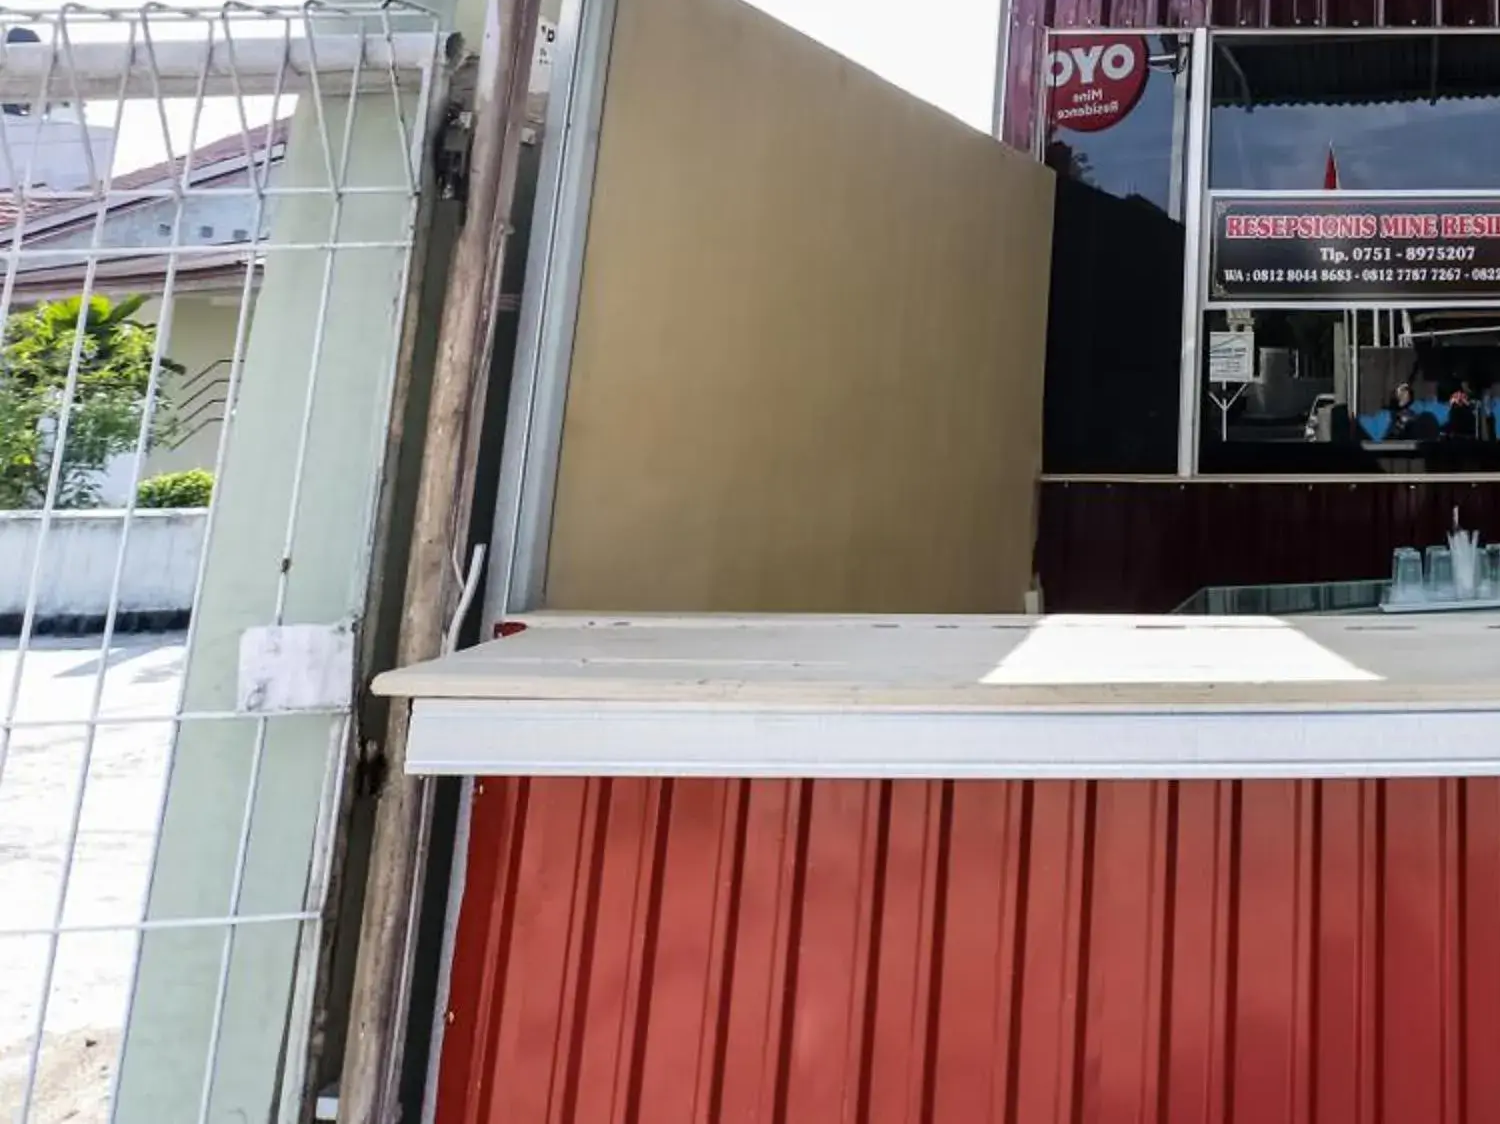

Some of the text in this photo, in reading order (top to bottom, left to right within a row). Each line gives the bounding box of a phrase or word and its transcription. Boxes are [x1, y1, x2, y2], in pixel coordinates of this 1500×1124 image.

[1225, 214, 1378, 239] RESEPSIONIS
[1379, 214, 1439, 239] MINE
[1352, 247, 1392, 261] 0751
[1405, 246, 1476, 261] 8975207
[1223, 269, 1244, 282] WA
[1252, 269, 1284, 282] 0812
